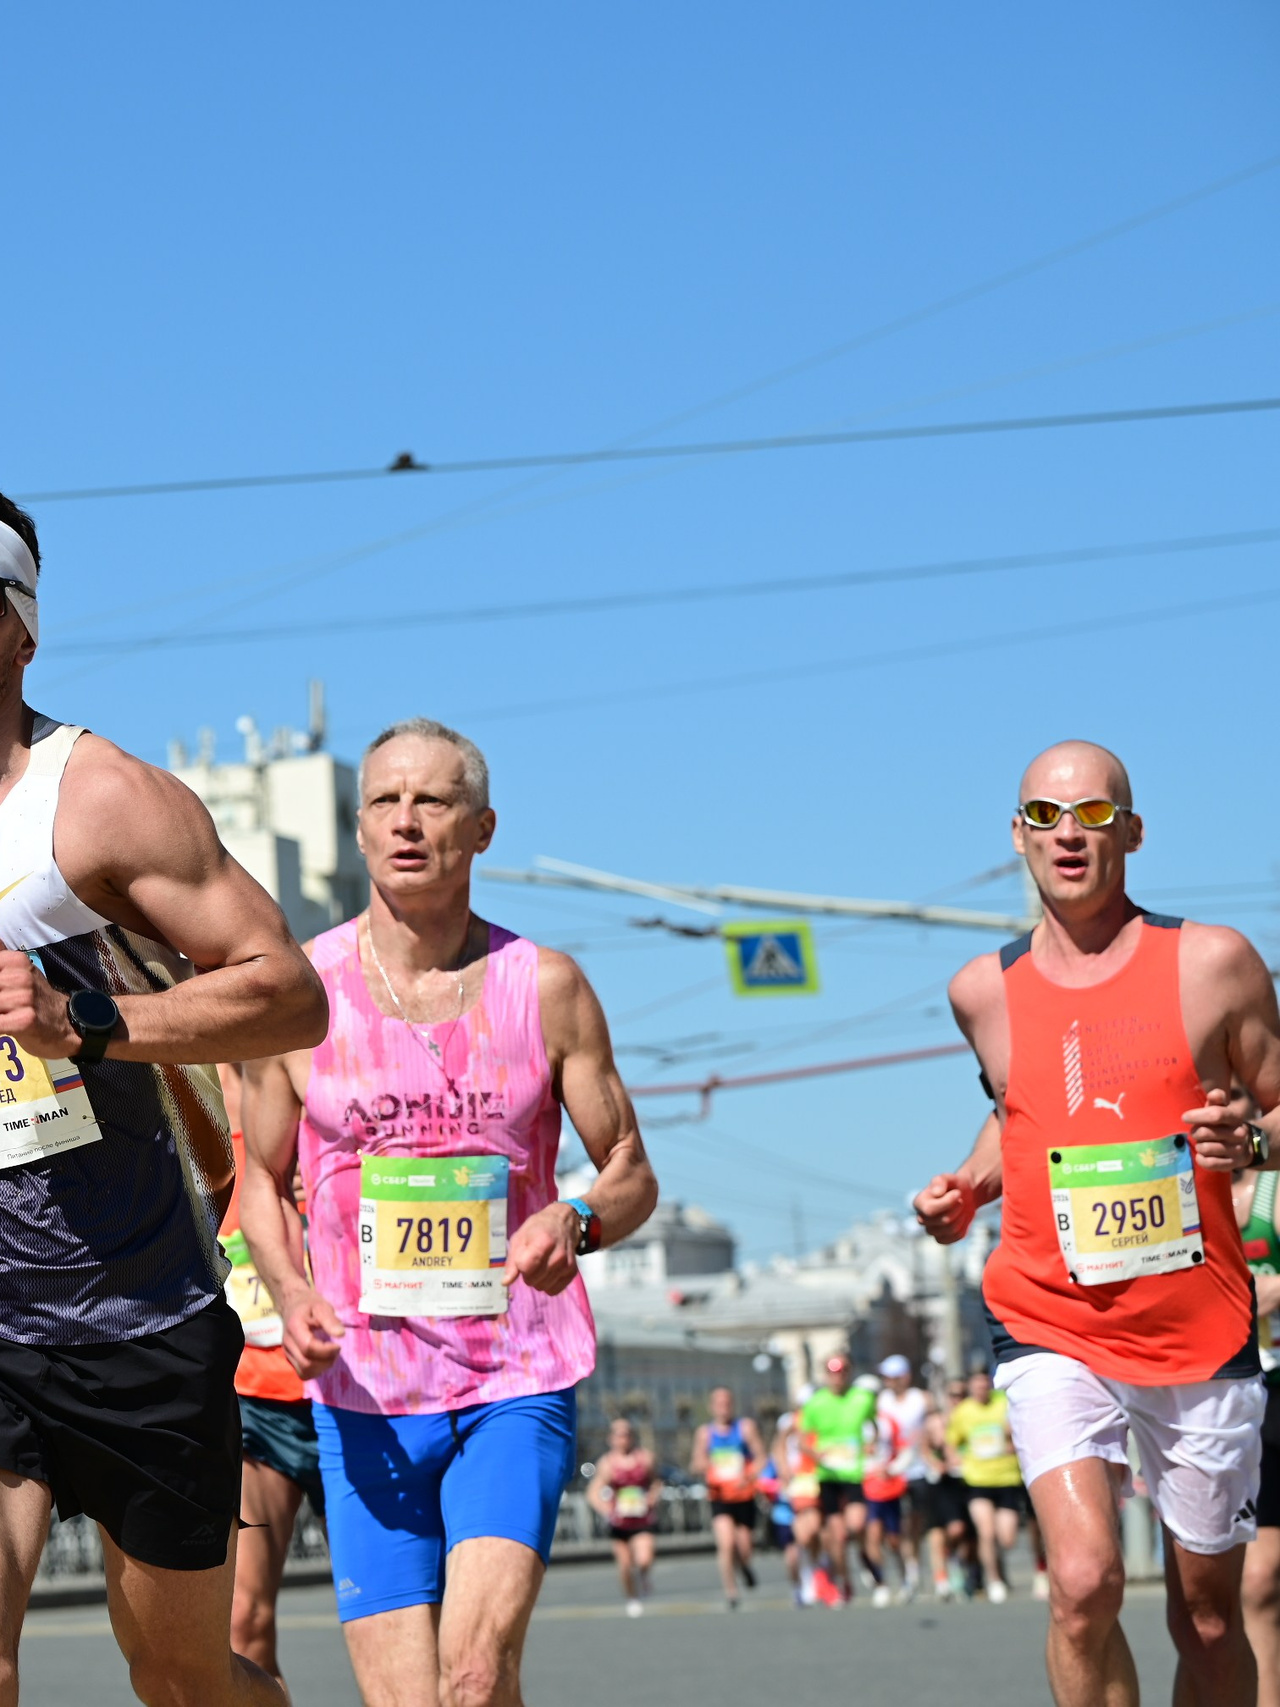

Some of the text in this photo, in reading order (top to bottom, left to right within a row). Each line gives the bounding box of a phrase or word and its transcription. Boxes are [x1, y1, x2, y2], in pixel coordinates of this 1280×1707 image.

[365, 1122, 480, 1137] RUNNING
[1092, 1194, 1166, 1237] 2950
[396, 1216, 474, 1254] 7819
[1111, 1232, 1150, 1249] СЕРГЕЙ
[412, 1256, 454, 1267] ANDREY
